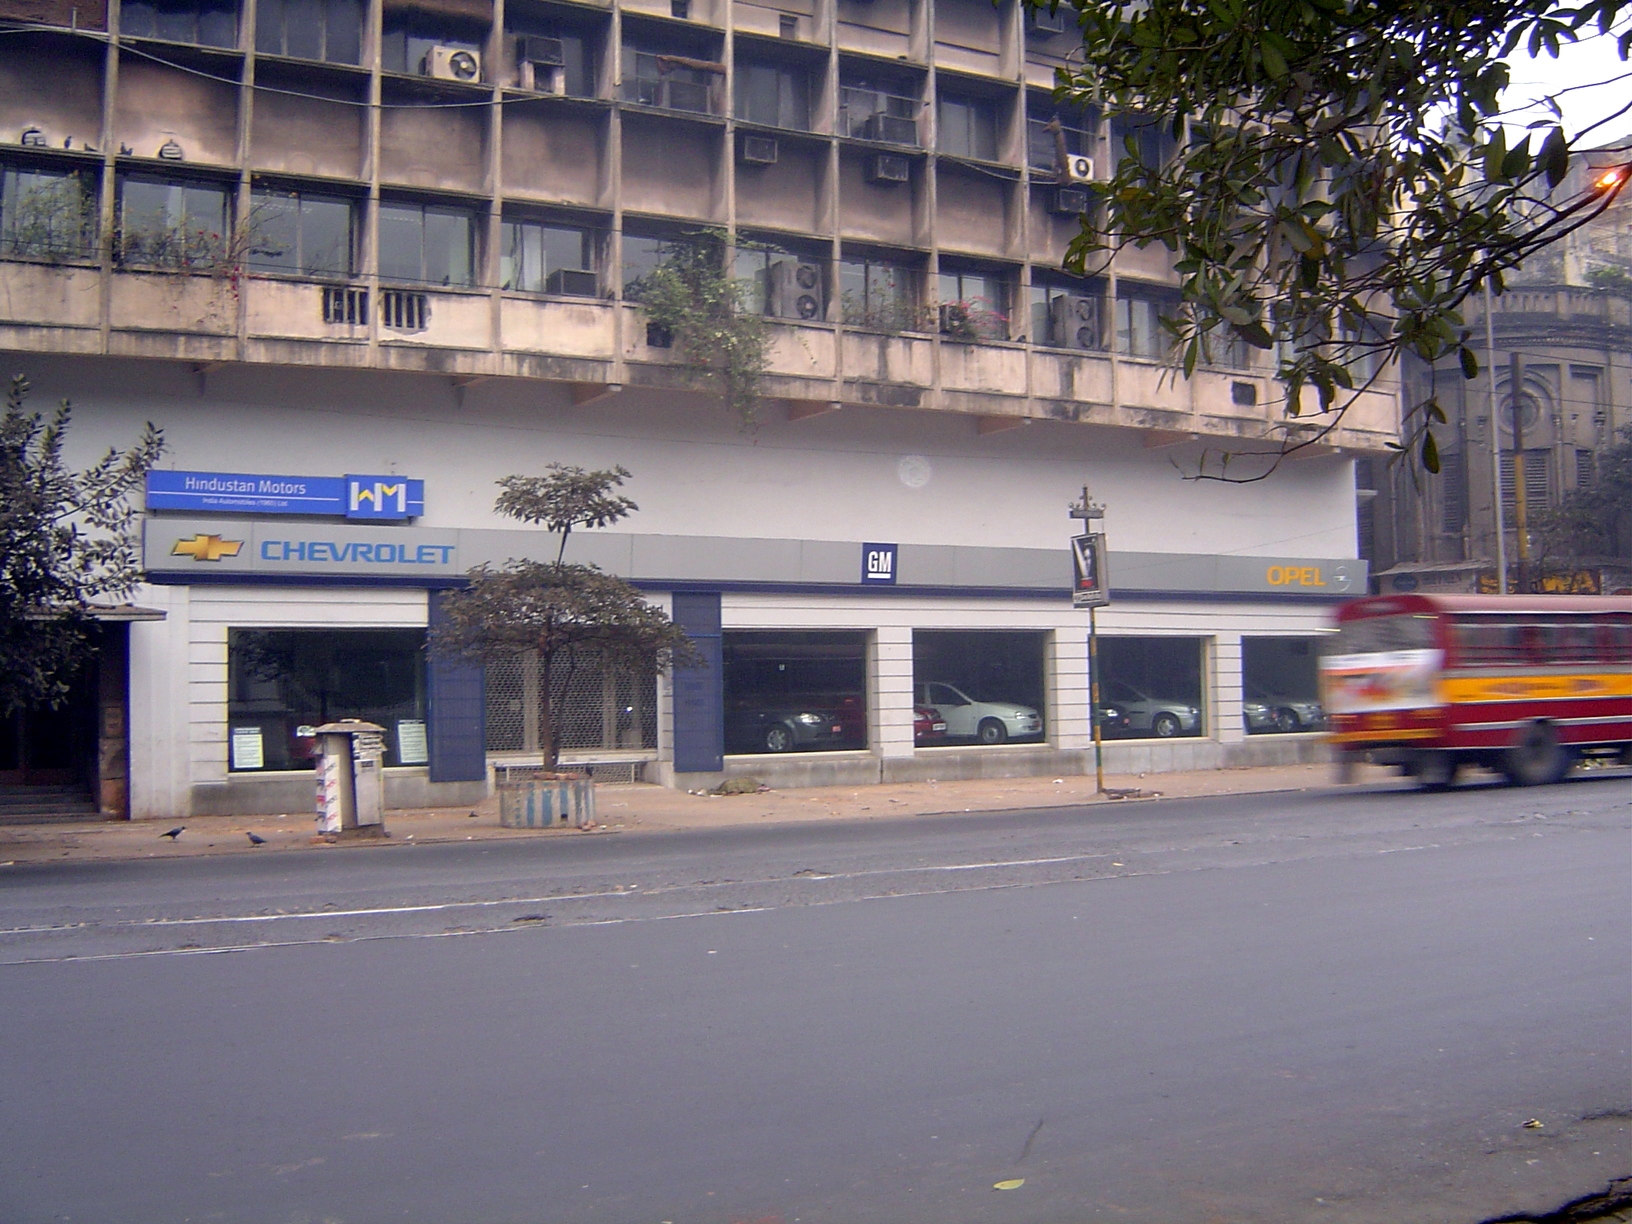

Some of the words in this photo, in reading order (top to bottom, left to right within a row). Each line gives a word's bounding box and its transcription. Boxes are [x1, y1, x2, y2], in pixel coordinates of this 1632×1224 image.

[185, 477, 255, 493] Hindustan
[259, 480, 306, 494] Motors
[261, 540, 455, 564] CHEVROLET
[868, 551, 892, 572] GM
[1266, 565, 1327, 586] OPEL
